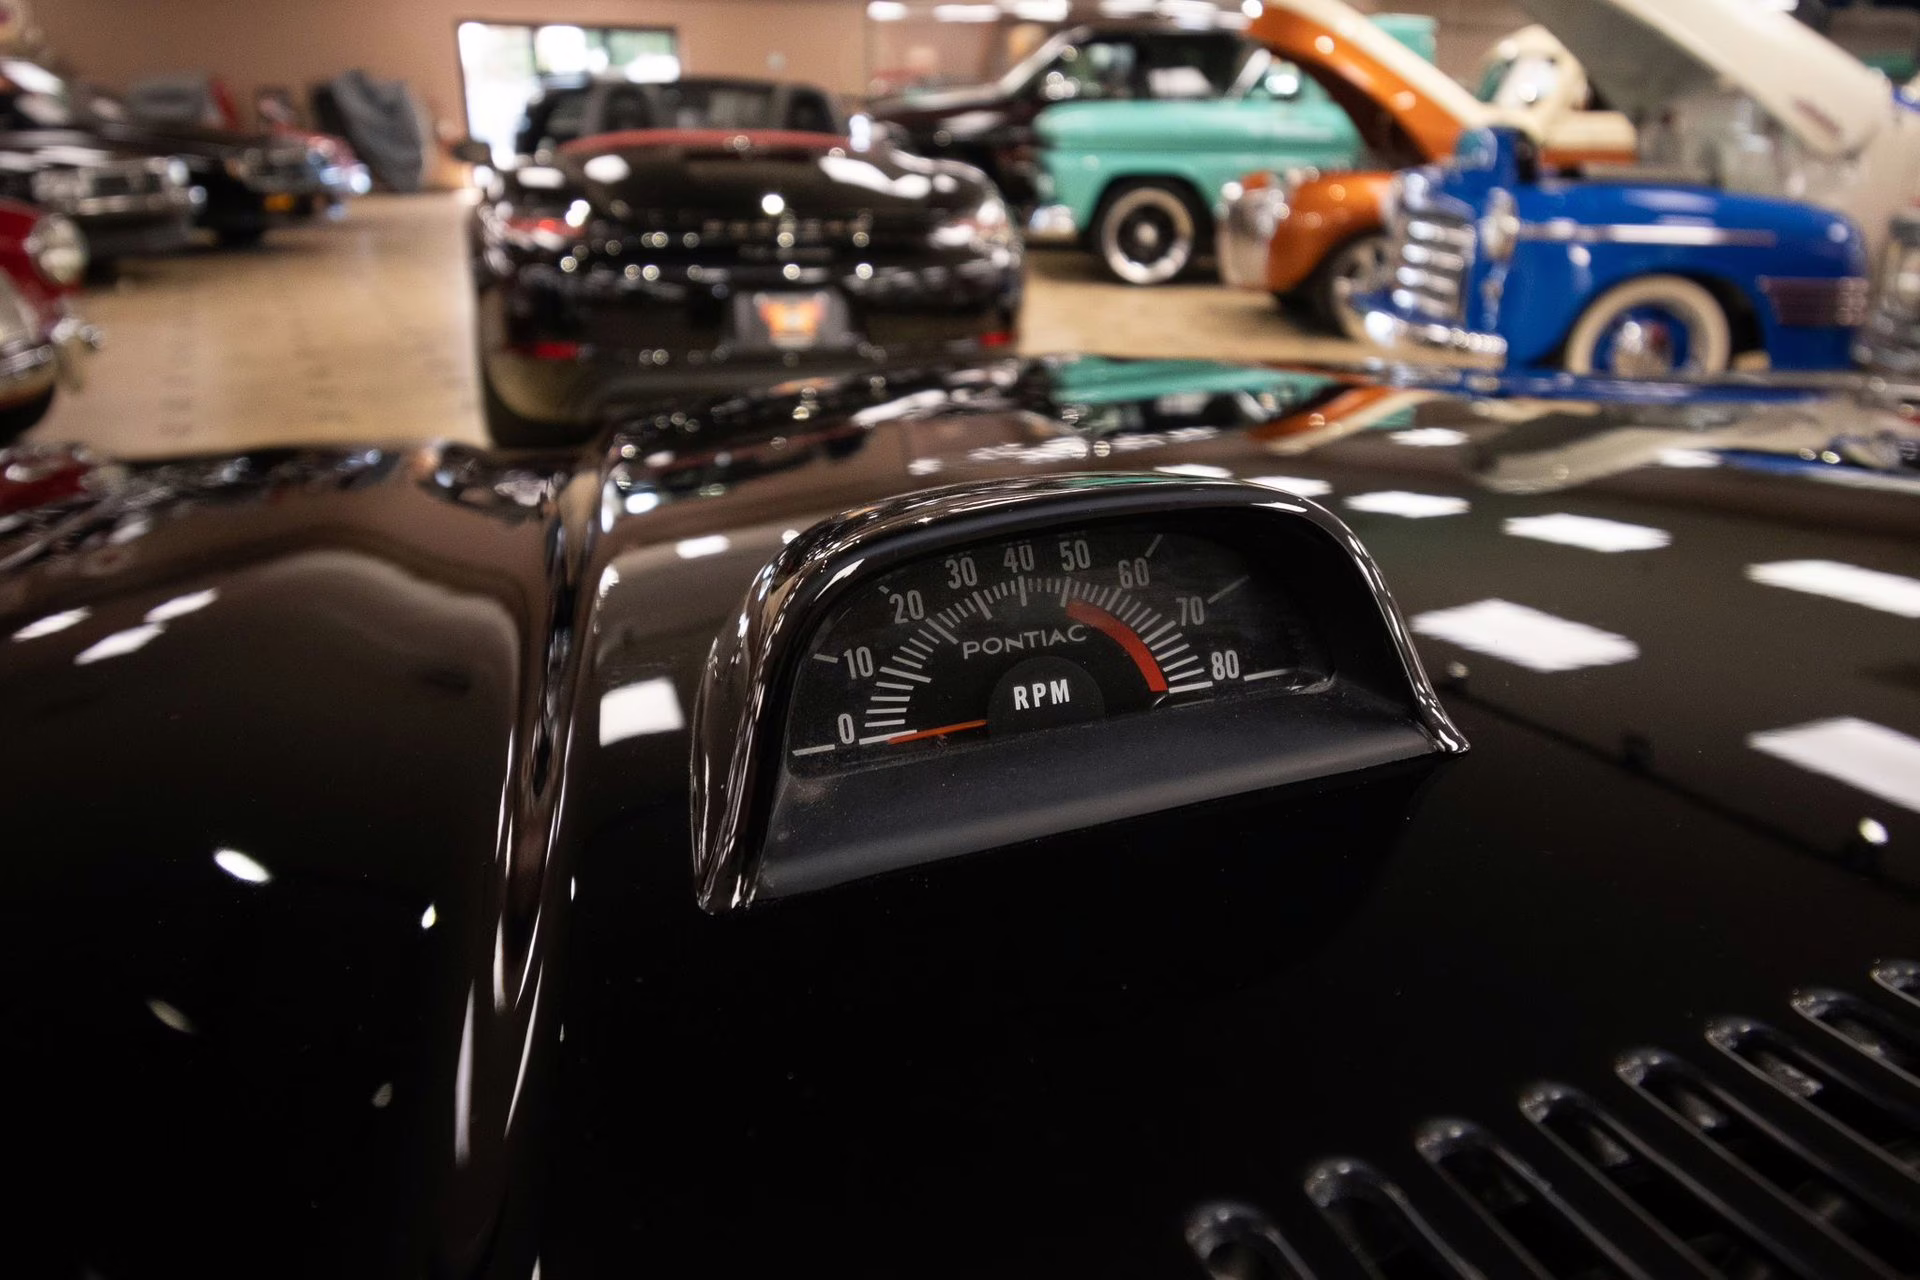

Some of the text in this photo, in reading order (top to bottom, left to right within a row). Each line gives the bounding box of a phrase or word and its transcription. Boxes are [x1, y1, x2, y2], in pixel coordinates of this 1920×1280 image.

[1003, 543, 1035, 574] 40
[1059, 539, 1091, 572] 50
[945, 556, 978, 590] 30
[1118, 557, 1151, 589] 60
[890, 589, 924, 626] 20
[1175, 597, 1206, 628] 70
[962, 624, 1088, 660] PONTIAC
[843, 646, 874, 680] 10
[1210, 650, 1241, 681] 80
[1013, 678, 1071, 711] RPM
[836, 713, 855, 745] 0
